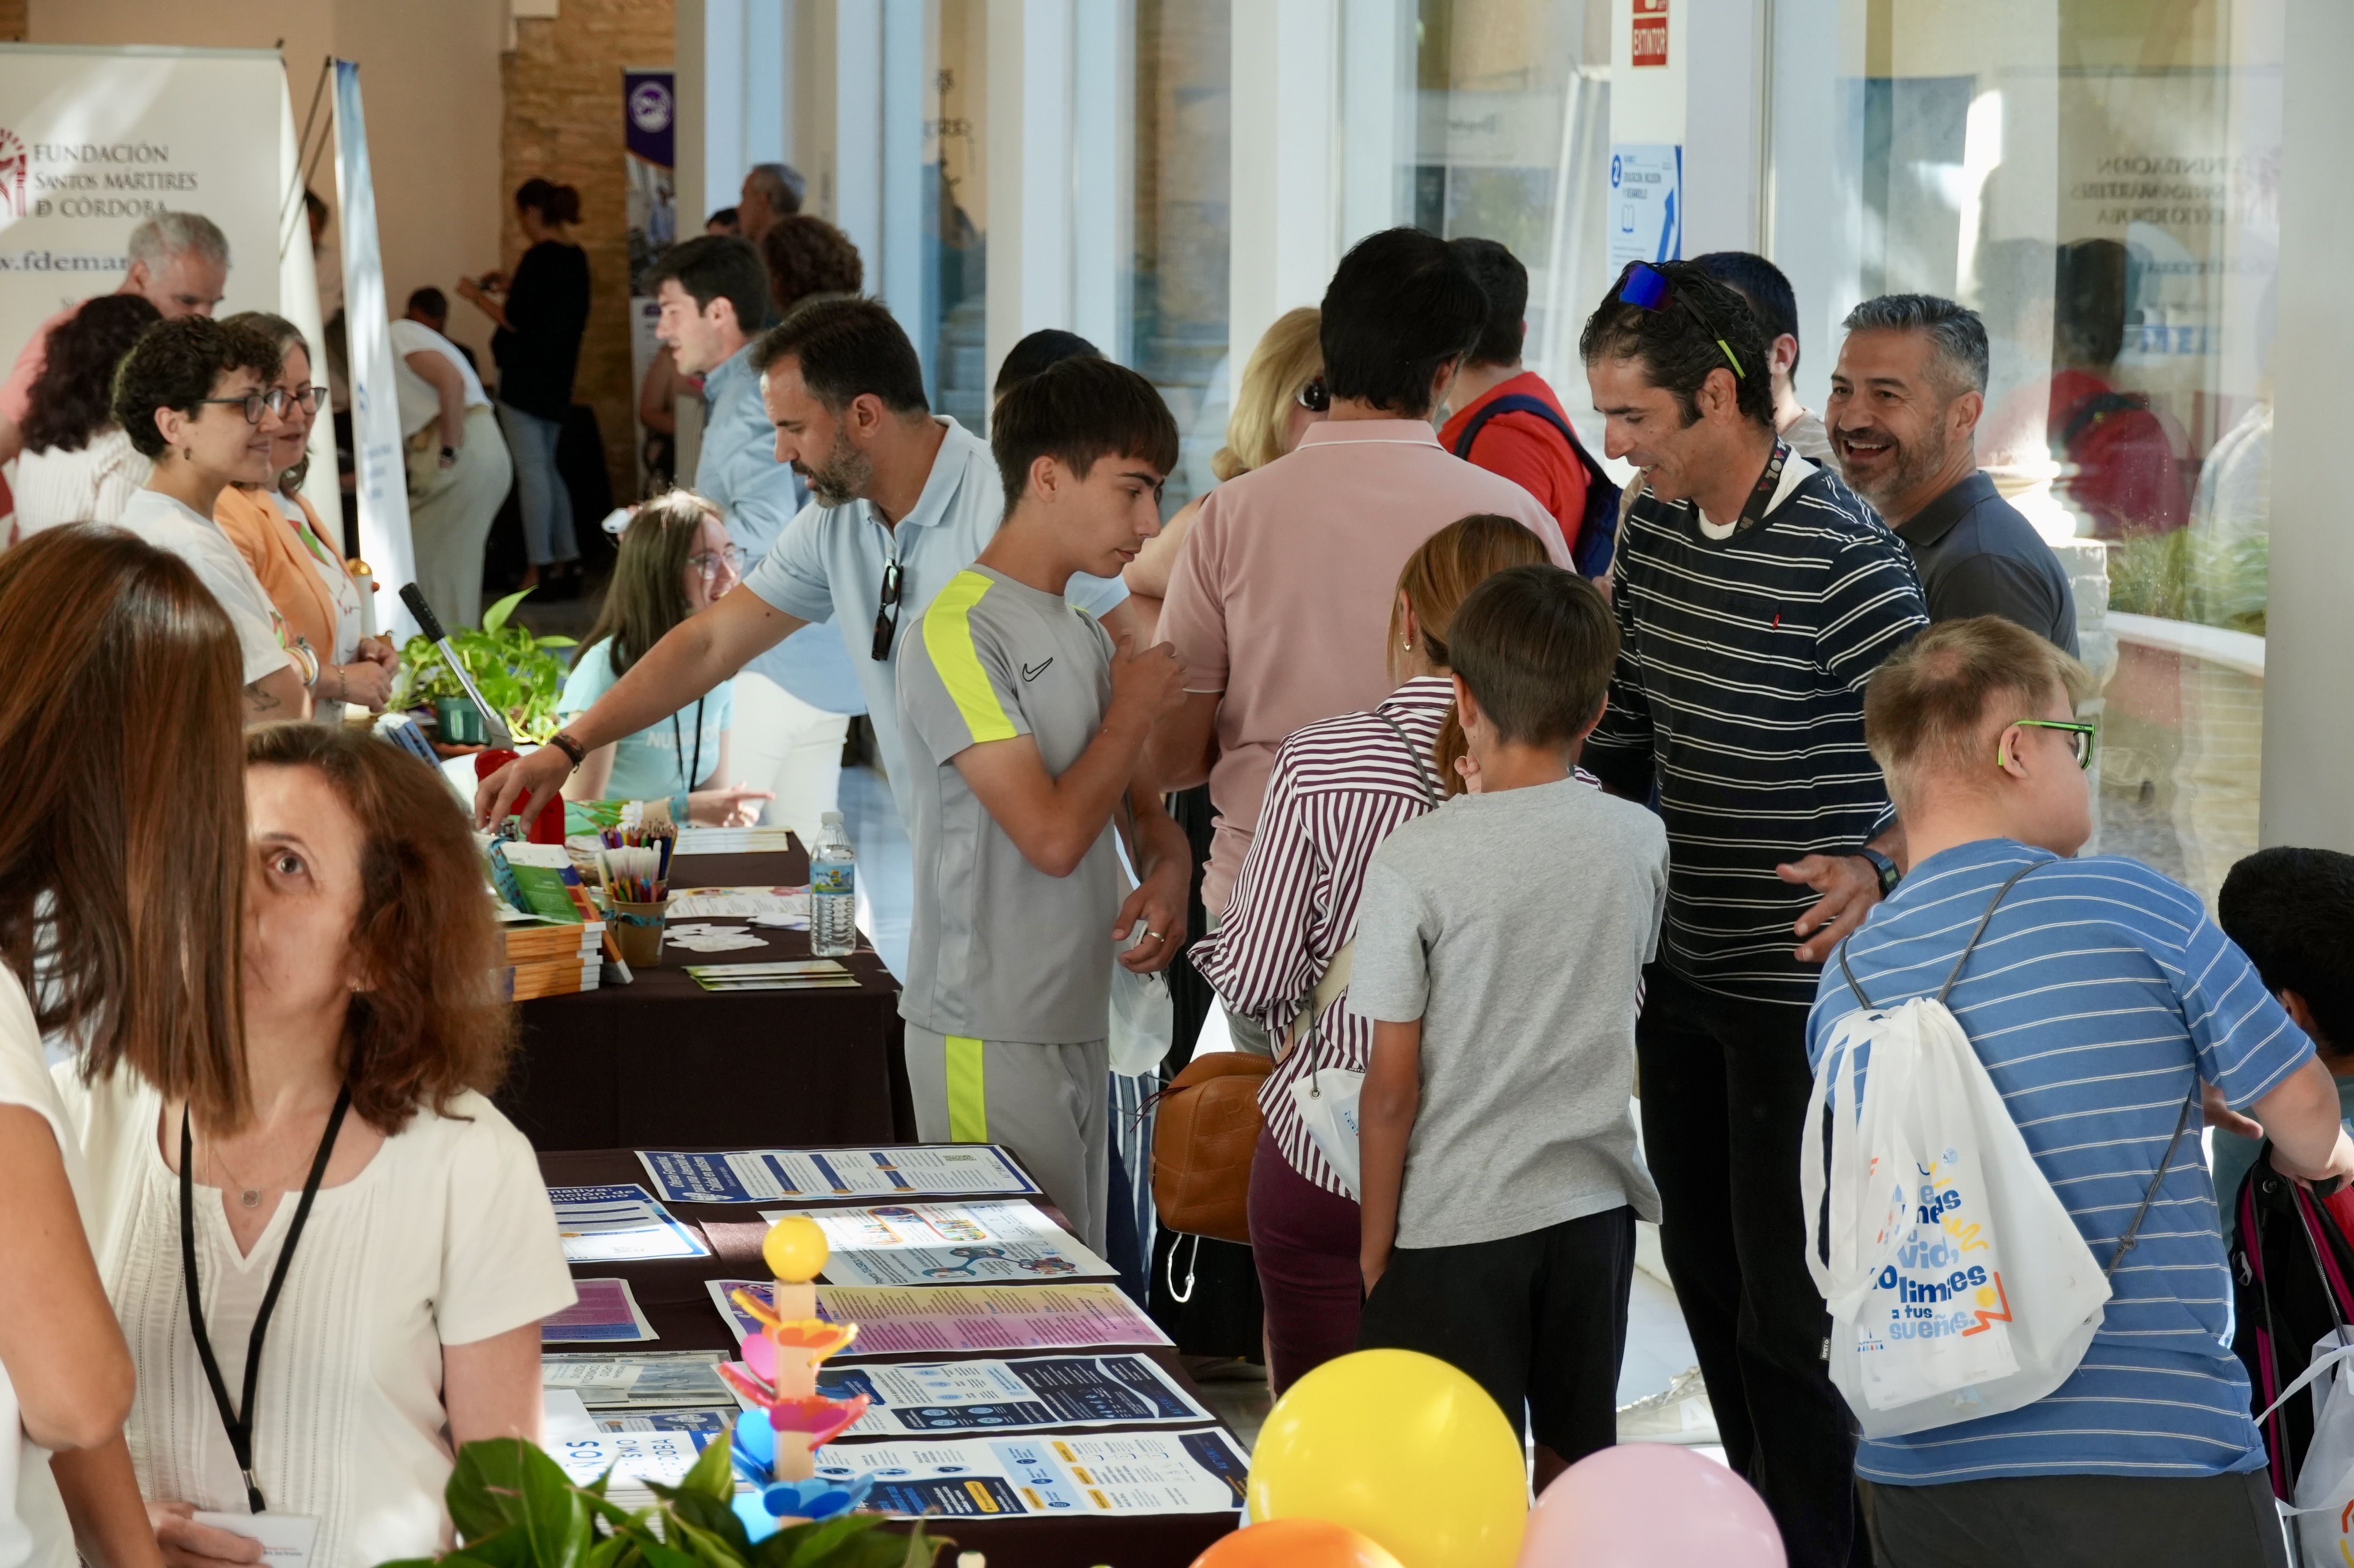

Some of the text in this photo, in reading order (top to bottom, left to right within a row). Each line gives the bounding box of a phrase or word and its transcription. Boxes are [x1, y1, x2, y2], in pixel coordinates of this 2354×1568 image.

[1634, 28, 1666, 56] EXTINTOR
[34, 142, 170, 163] FUNDACIÓN
[105, 167, 199, 191] MÁRTIRES
[1612, 161, 1620, 184] 2
[691, 1156, 713, 1171] autismo
[686, 1175, 701, 1184] una
[702, 1177, 725, 1190] Calidad
[552, 1194, 629, 1202] autismo
[1892, 1304, 1932, 1319] a tus
